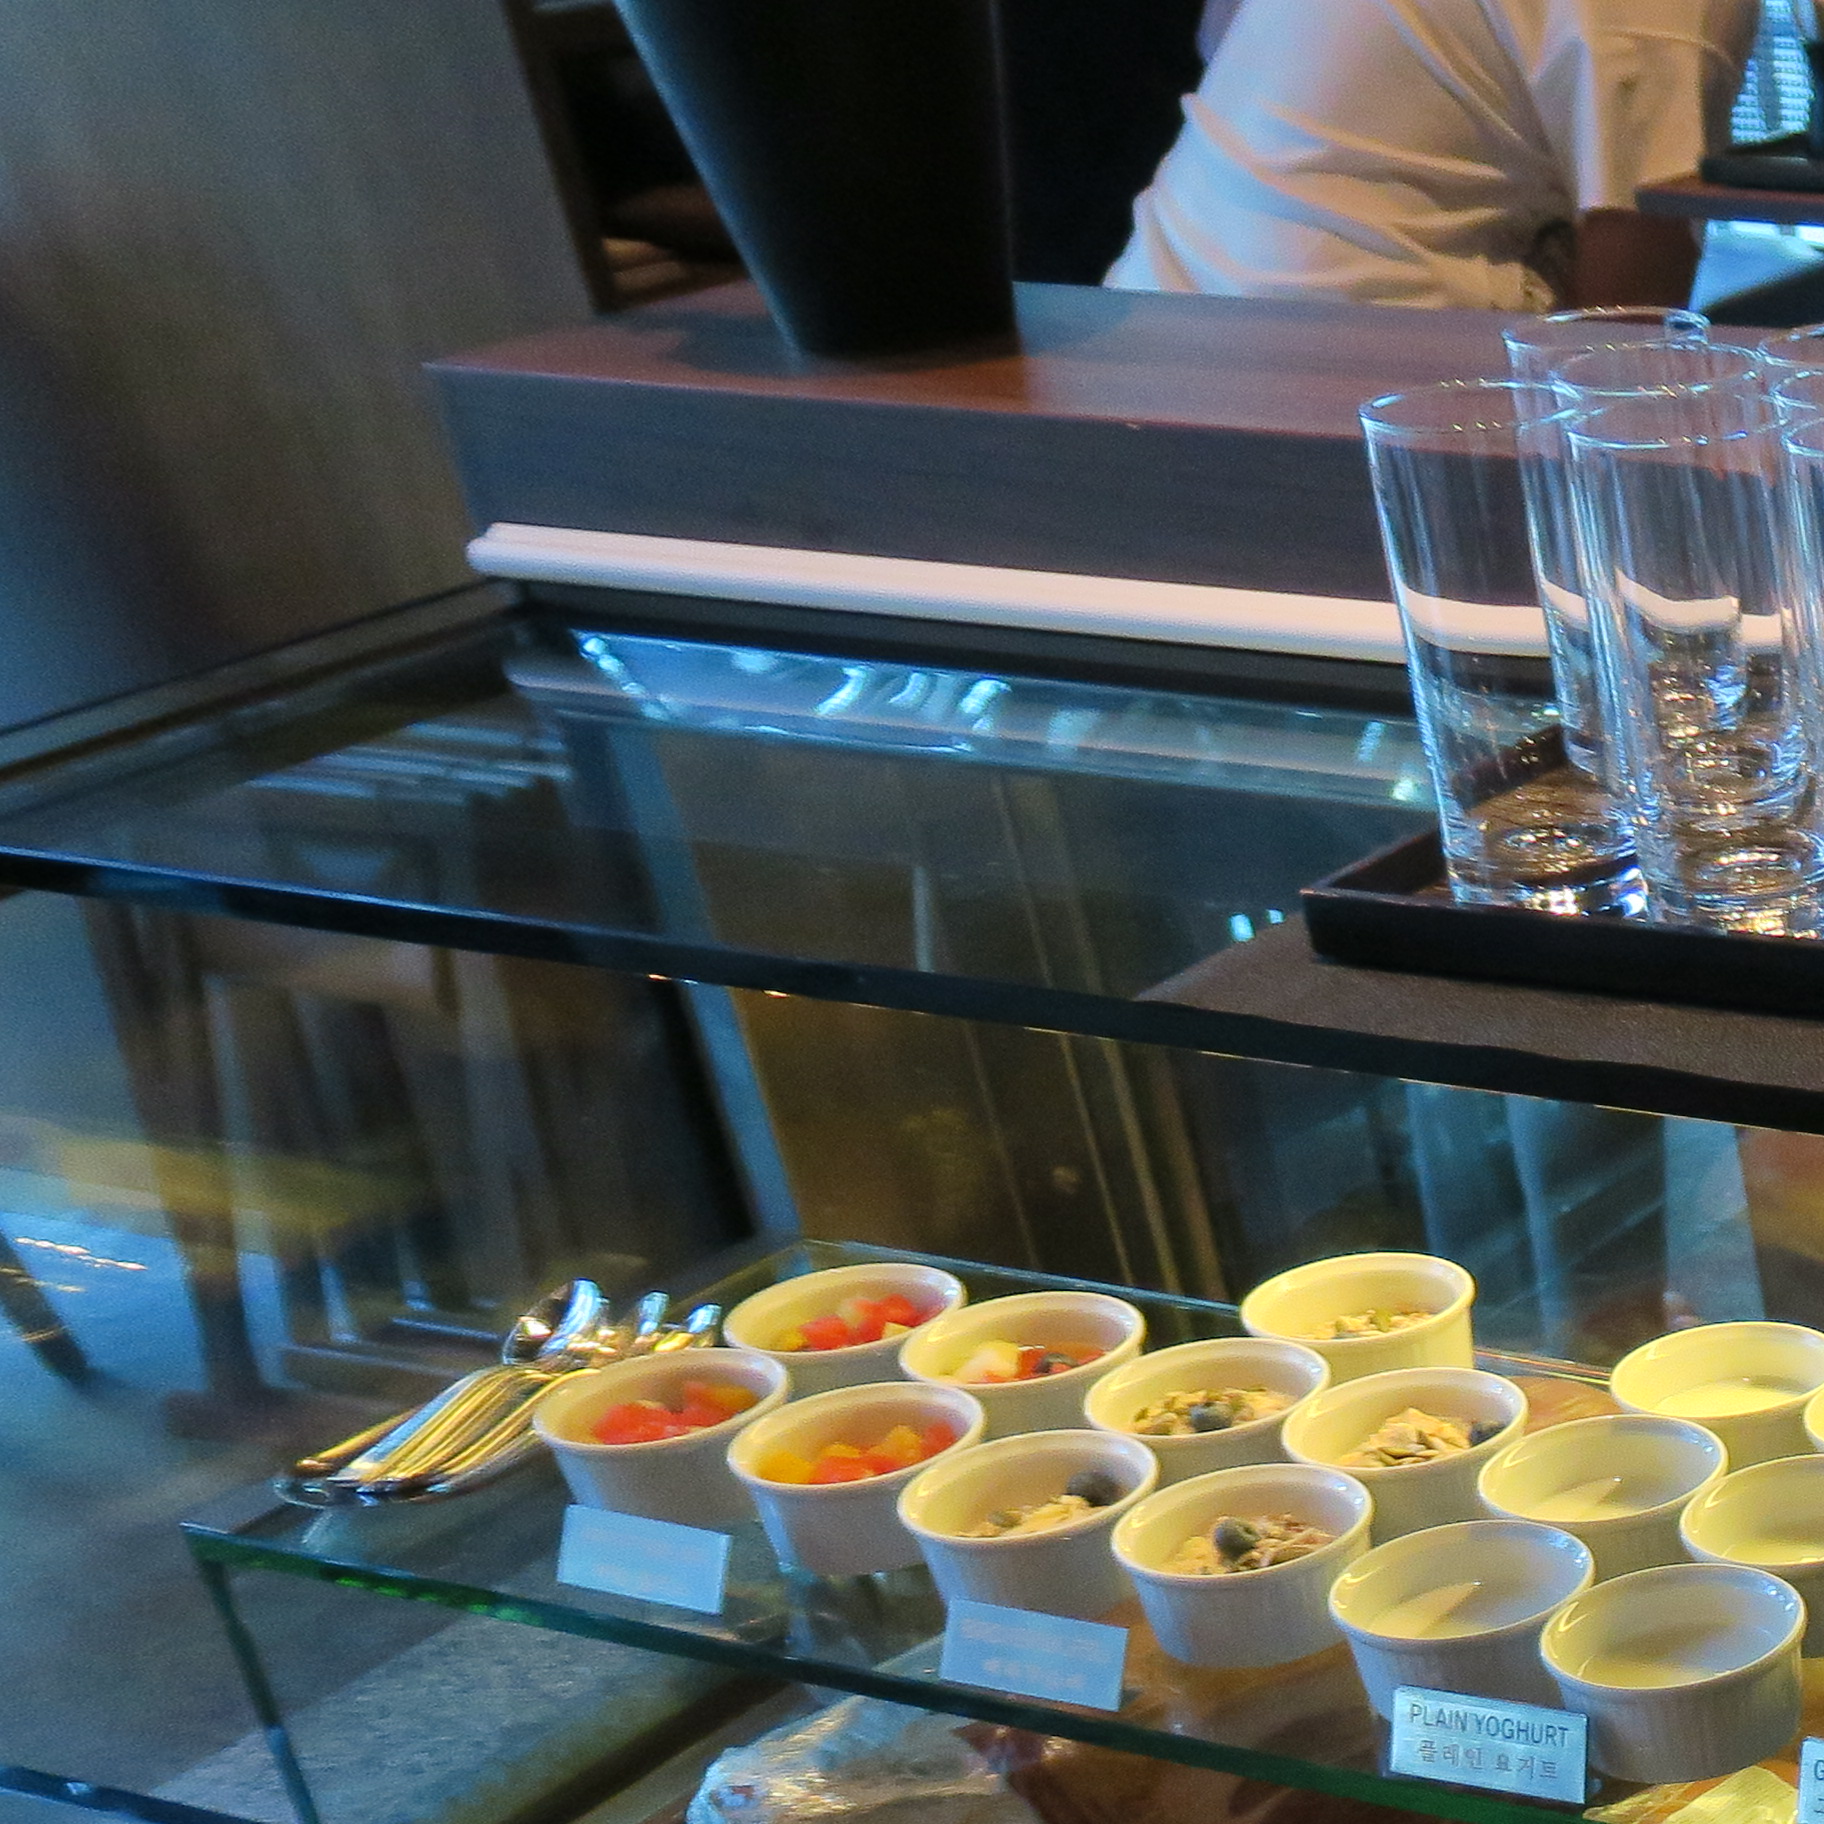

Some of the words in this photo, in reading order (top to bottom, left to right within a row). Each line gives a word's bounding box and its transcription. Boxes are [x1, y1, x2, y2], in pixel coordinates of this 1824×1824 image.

[1409, 1703, 1468, 1734] PLAIN
[1473, 1711, 1570, 1749] YOGHURT
[1418, 1738, 1485, 1770] 플레인
[1494, 1753, 1559, 1781] 요거트
